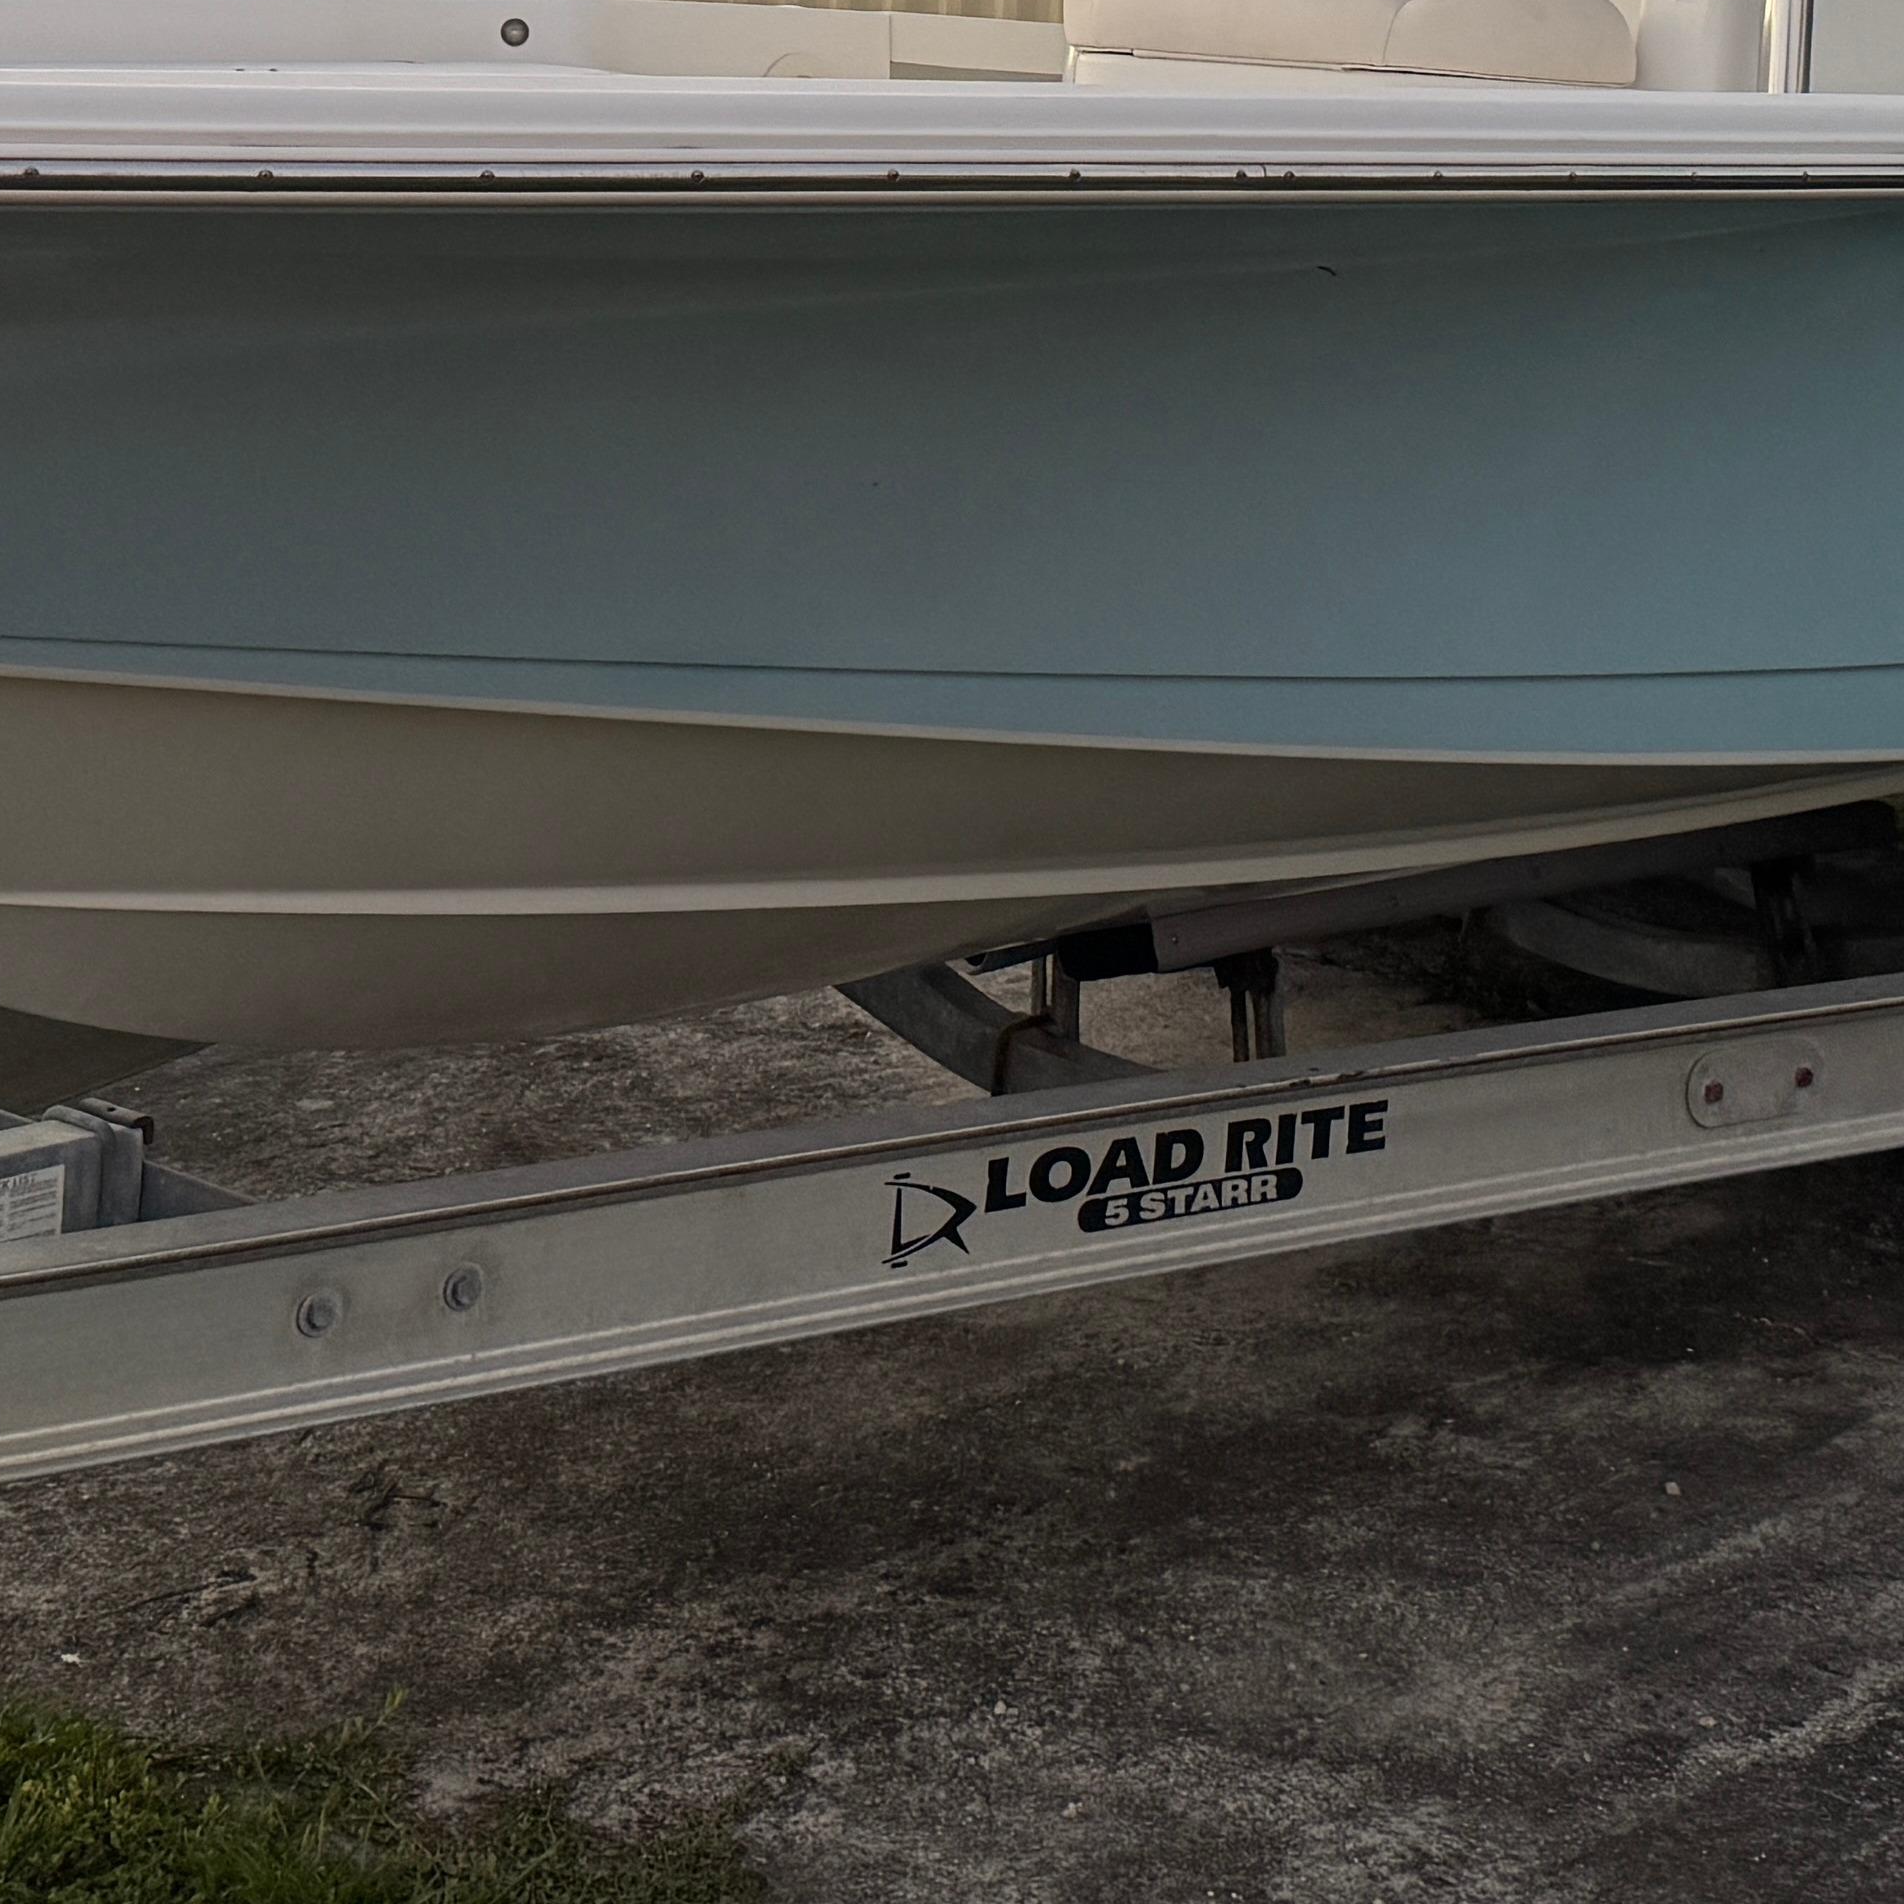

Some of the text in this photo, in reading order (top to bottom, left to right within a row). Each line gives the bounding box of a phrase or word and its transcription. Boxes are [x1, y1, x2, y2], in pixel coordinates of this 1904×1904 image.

[984, 1100, 1389, 1212] LOAD RITE
[1104, 1177, 1279, 1227] 5 STARR
